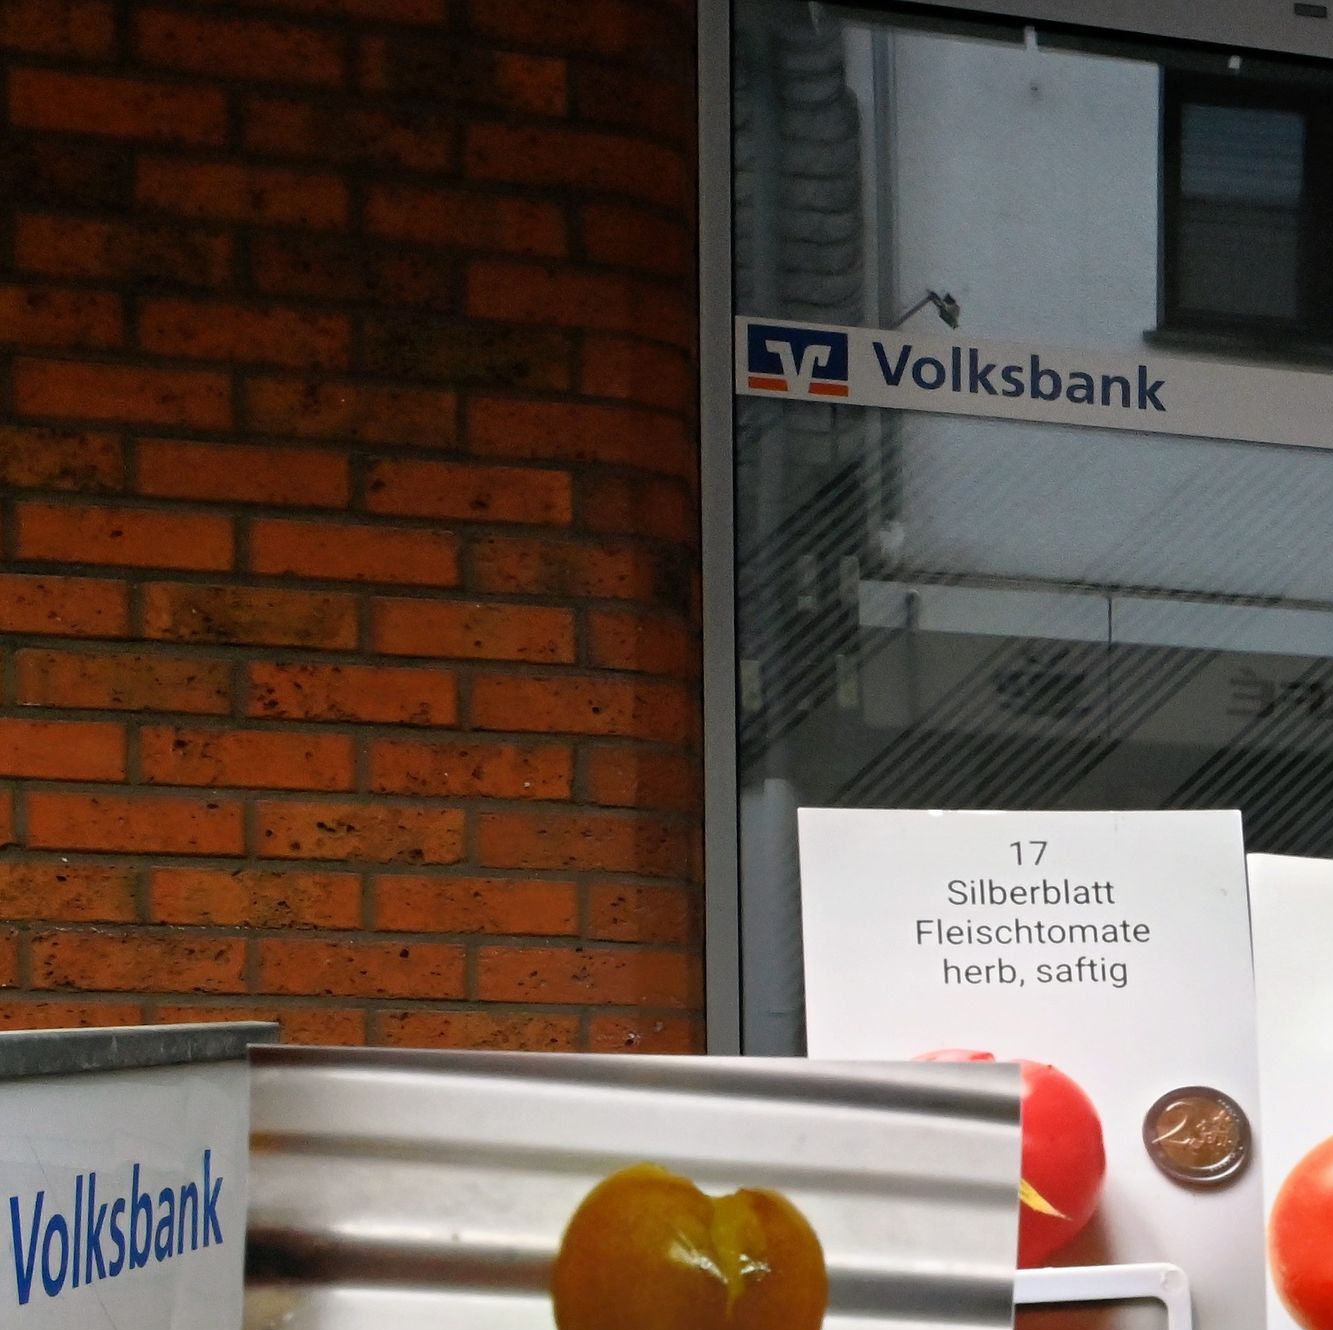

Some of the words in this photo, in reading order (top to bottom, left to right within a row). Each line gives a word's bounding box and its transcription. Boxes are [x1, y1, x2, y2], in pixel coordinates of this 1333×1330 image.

[872, 342, 1167, 411] Volksbank
[1010, 840, 1048, 866] 17
[947, 879, 1115, 905] Silberblatt
[915, 918, 1151, 945] Fleischtomate
[943, 958, 1025, 987] herb,
[1036, 956, 1128, 988] saftig
[9, 1149, 224, 1306] Volksbank
